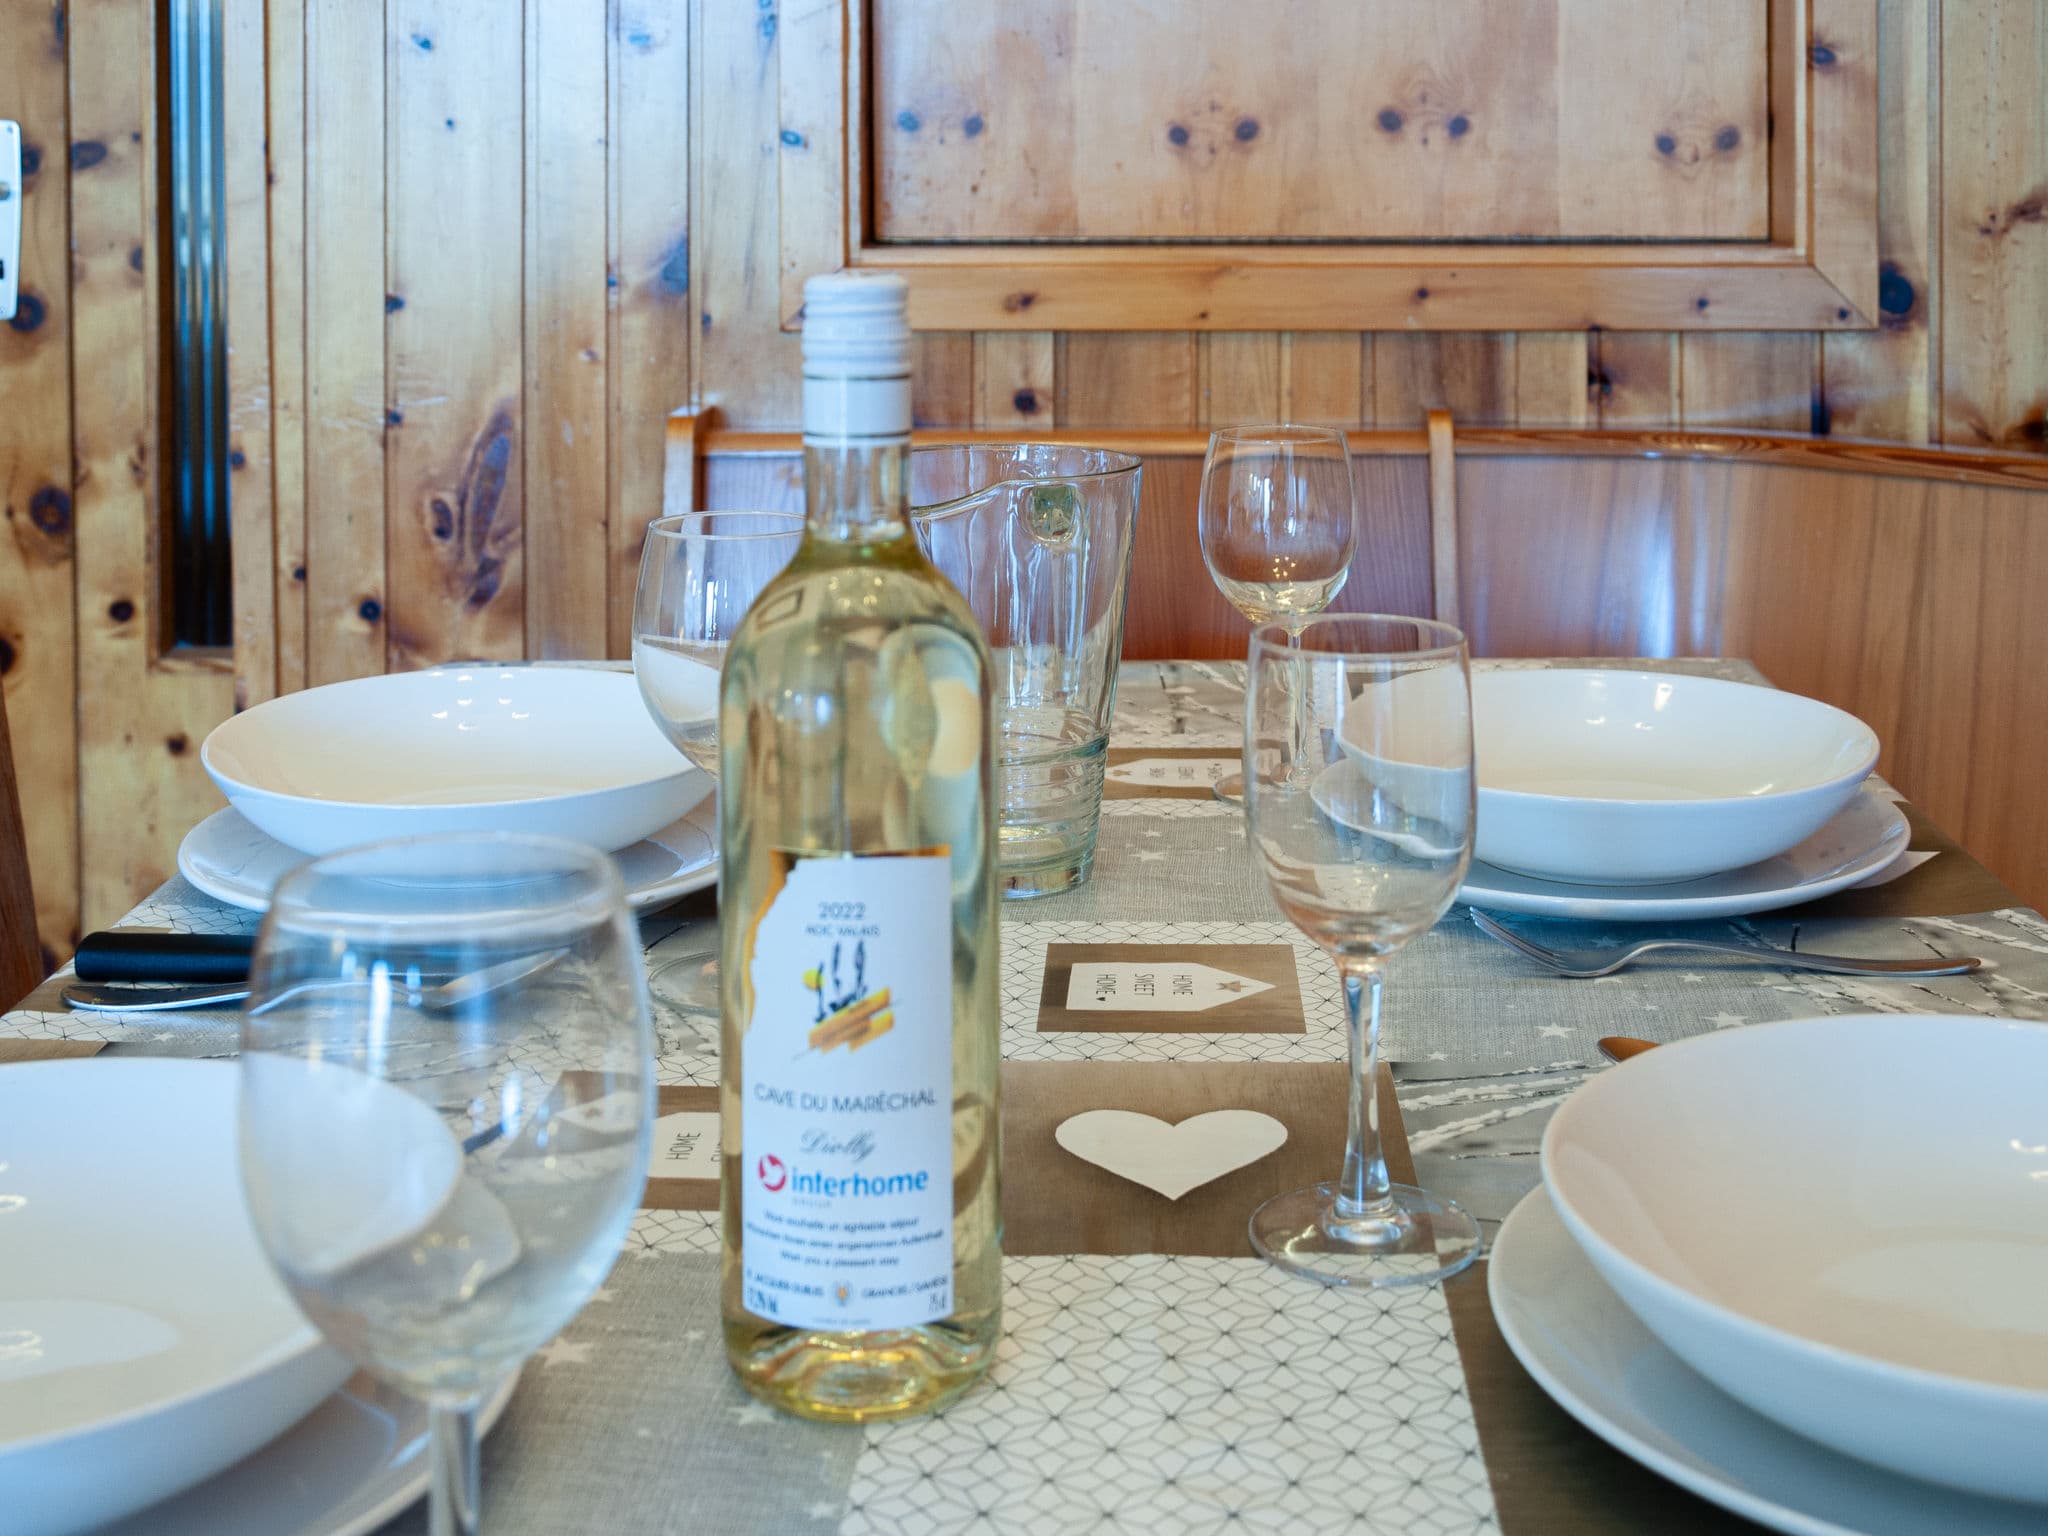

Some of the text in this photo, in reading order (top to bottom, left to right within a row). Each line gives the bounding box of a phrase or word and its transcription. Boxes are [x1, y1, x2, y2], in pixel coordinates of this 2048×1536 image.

[818, 902, 865, 920] 2022
[1095, 973, 1117, 995] HOME
[1134, 973, 1155, 998] SWEET
[1172, 973, 1194, 997] HOME
[753, 1082, 938, 1114] CAVE DU MARÉCHAL
[664, 1131, 702, 1161] HOME
[791, 1165, 930, 1198] interhome
